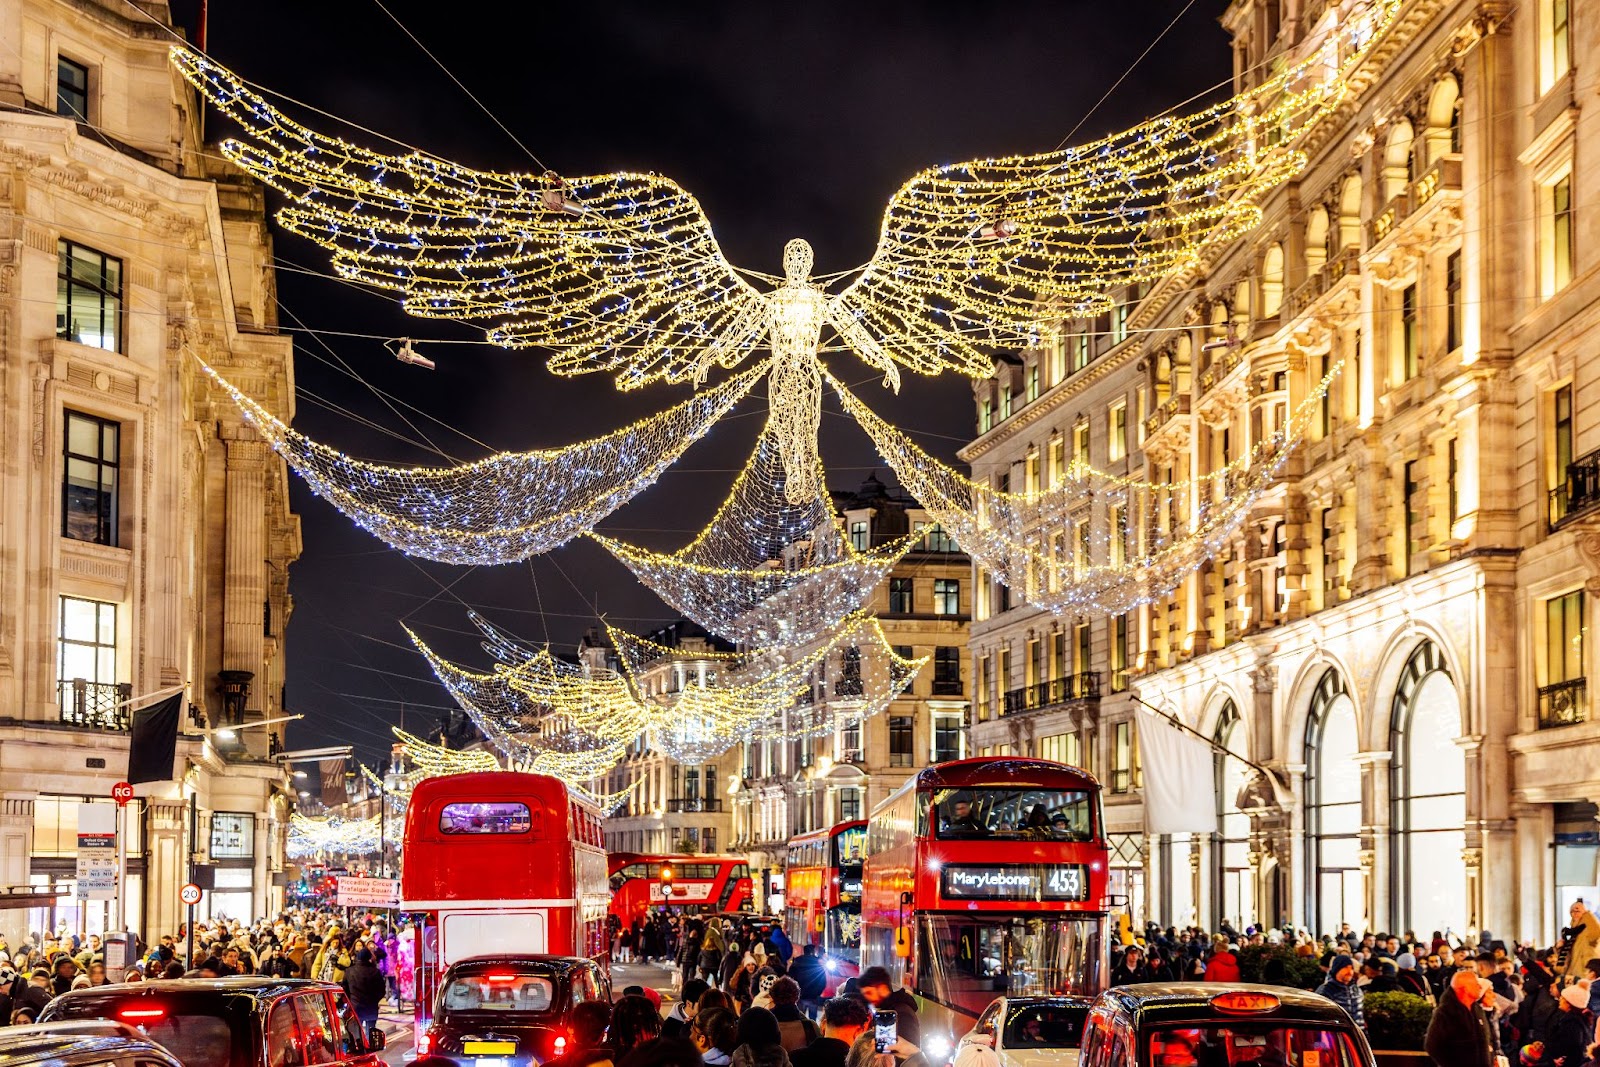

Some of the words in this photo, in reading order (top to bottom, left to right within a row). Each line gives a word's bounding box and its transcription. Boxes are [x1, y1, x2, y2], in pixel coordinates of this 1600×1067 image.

[115, 787, 130, 797] RG
[340, 879, 370, 887] Piccadilly
[953, 871, 1031, 888] Marylebone
[1048, 870, 1079, 892] 453
[183, 889, 198, 899] 20
[1226, 996, 1267, 1008] TAXI
